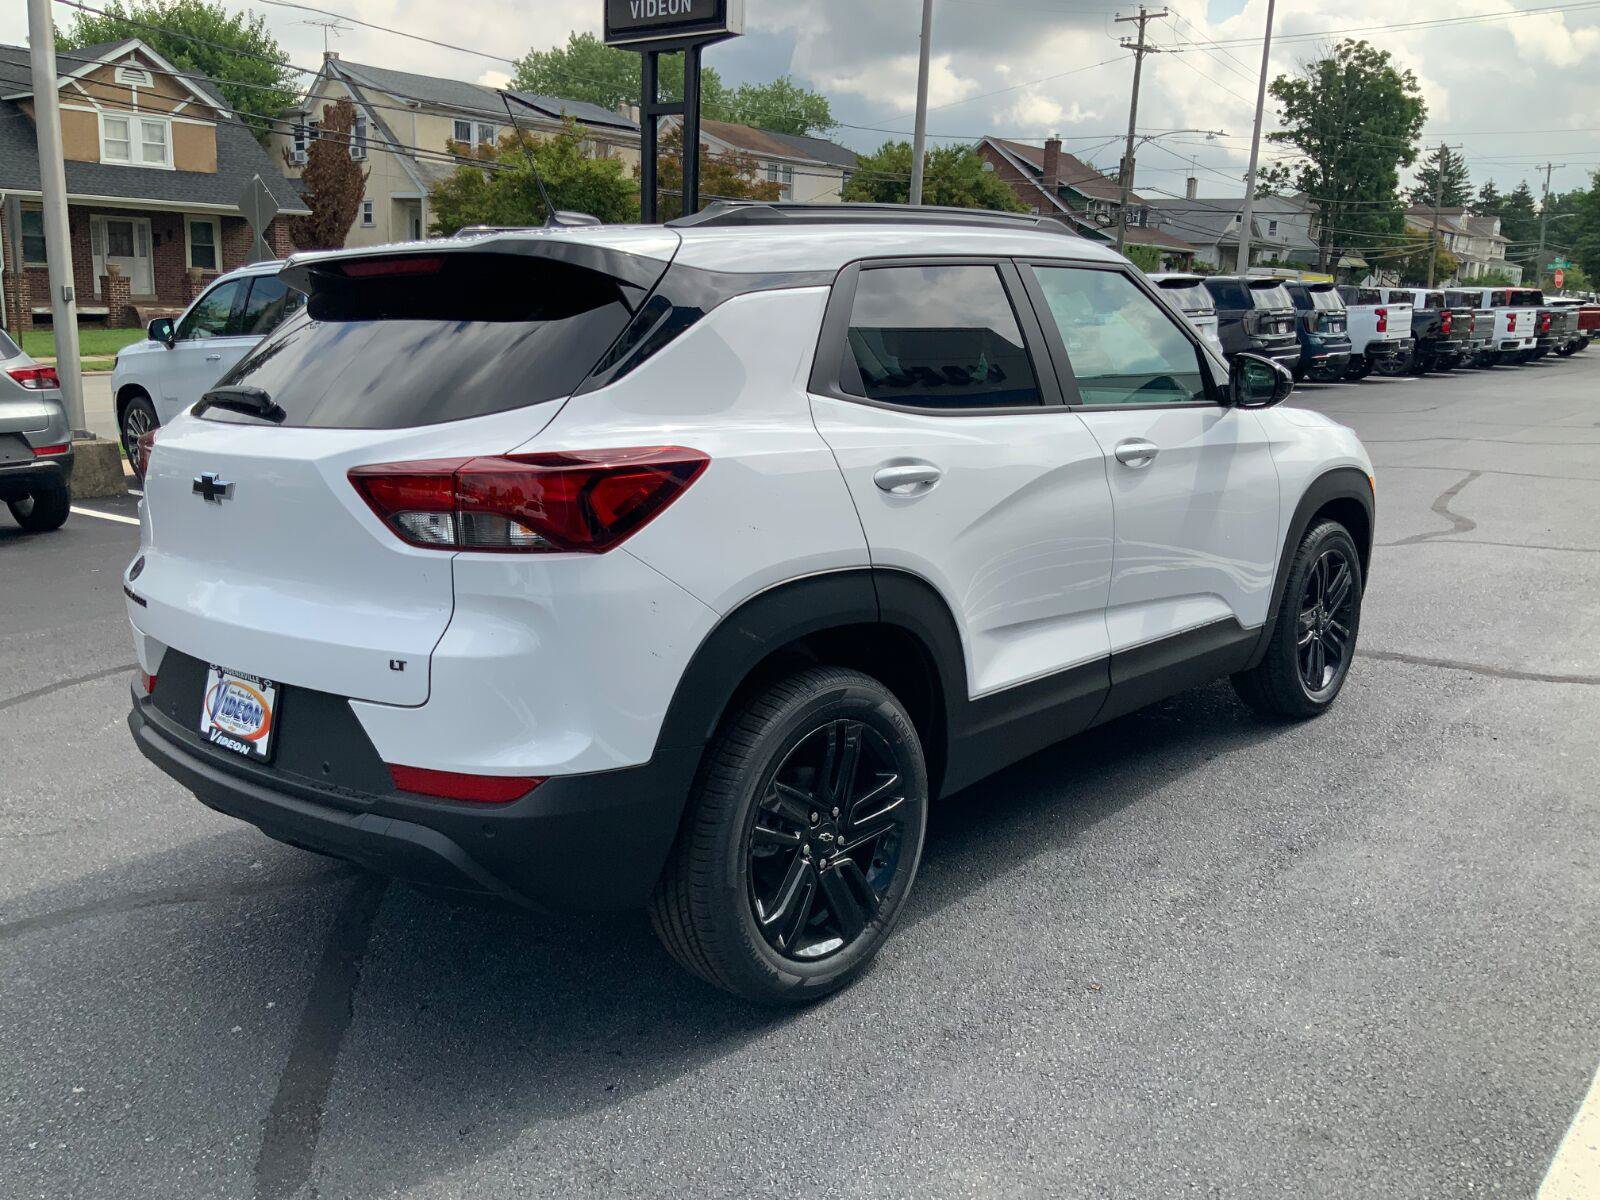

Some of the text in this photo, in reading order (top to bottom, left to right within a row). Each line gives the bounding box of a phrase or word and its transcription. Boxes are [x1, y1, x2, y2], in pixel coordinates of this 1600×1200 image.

[630, 0, 692, 19] VIDEON
[390, 659, 407, 671] LT
[210, 729, 250, 755] VIDEON
